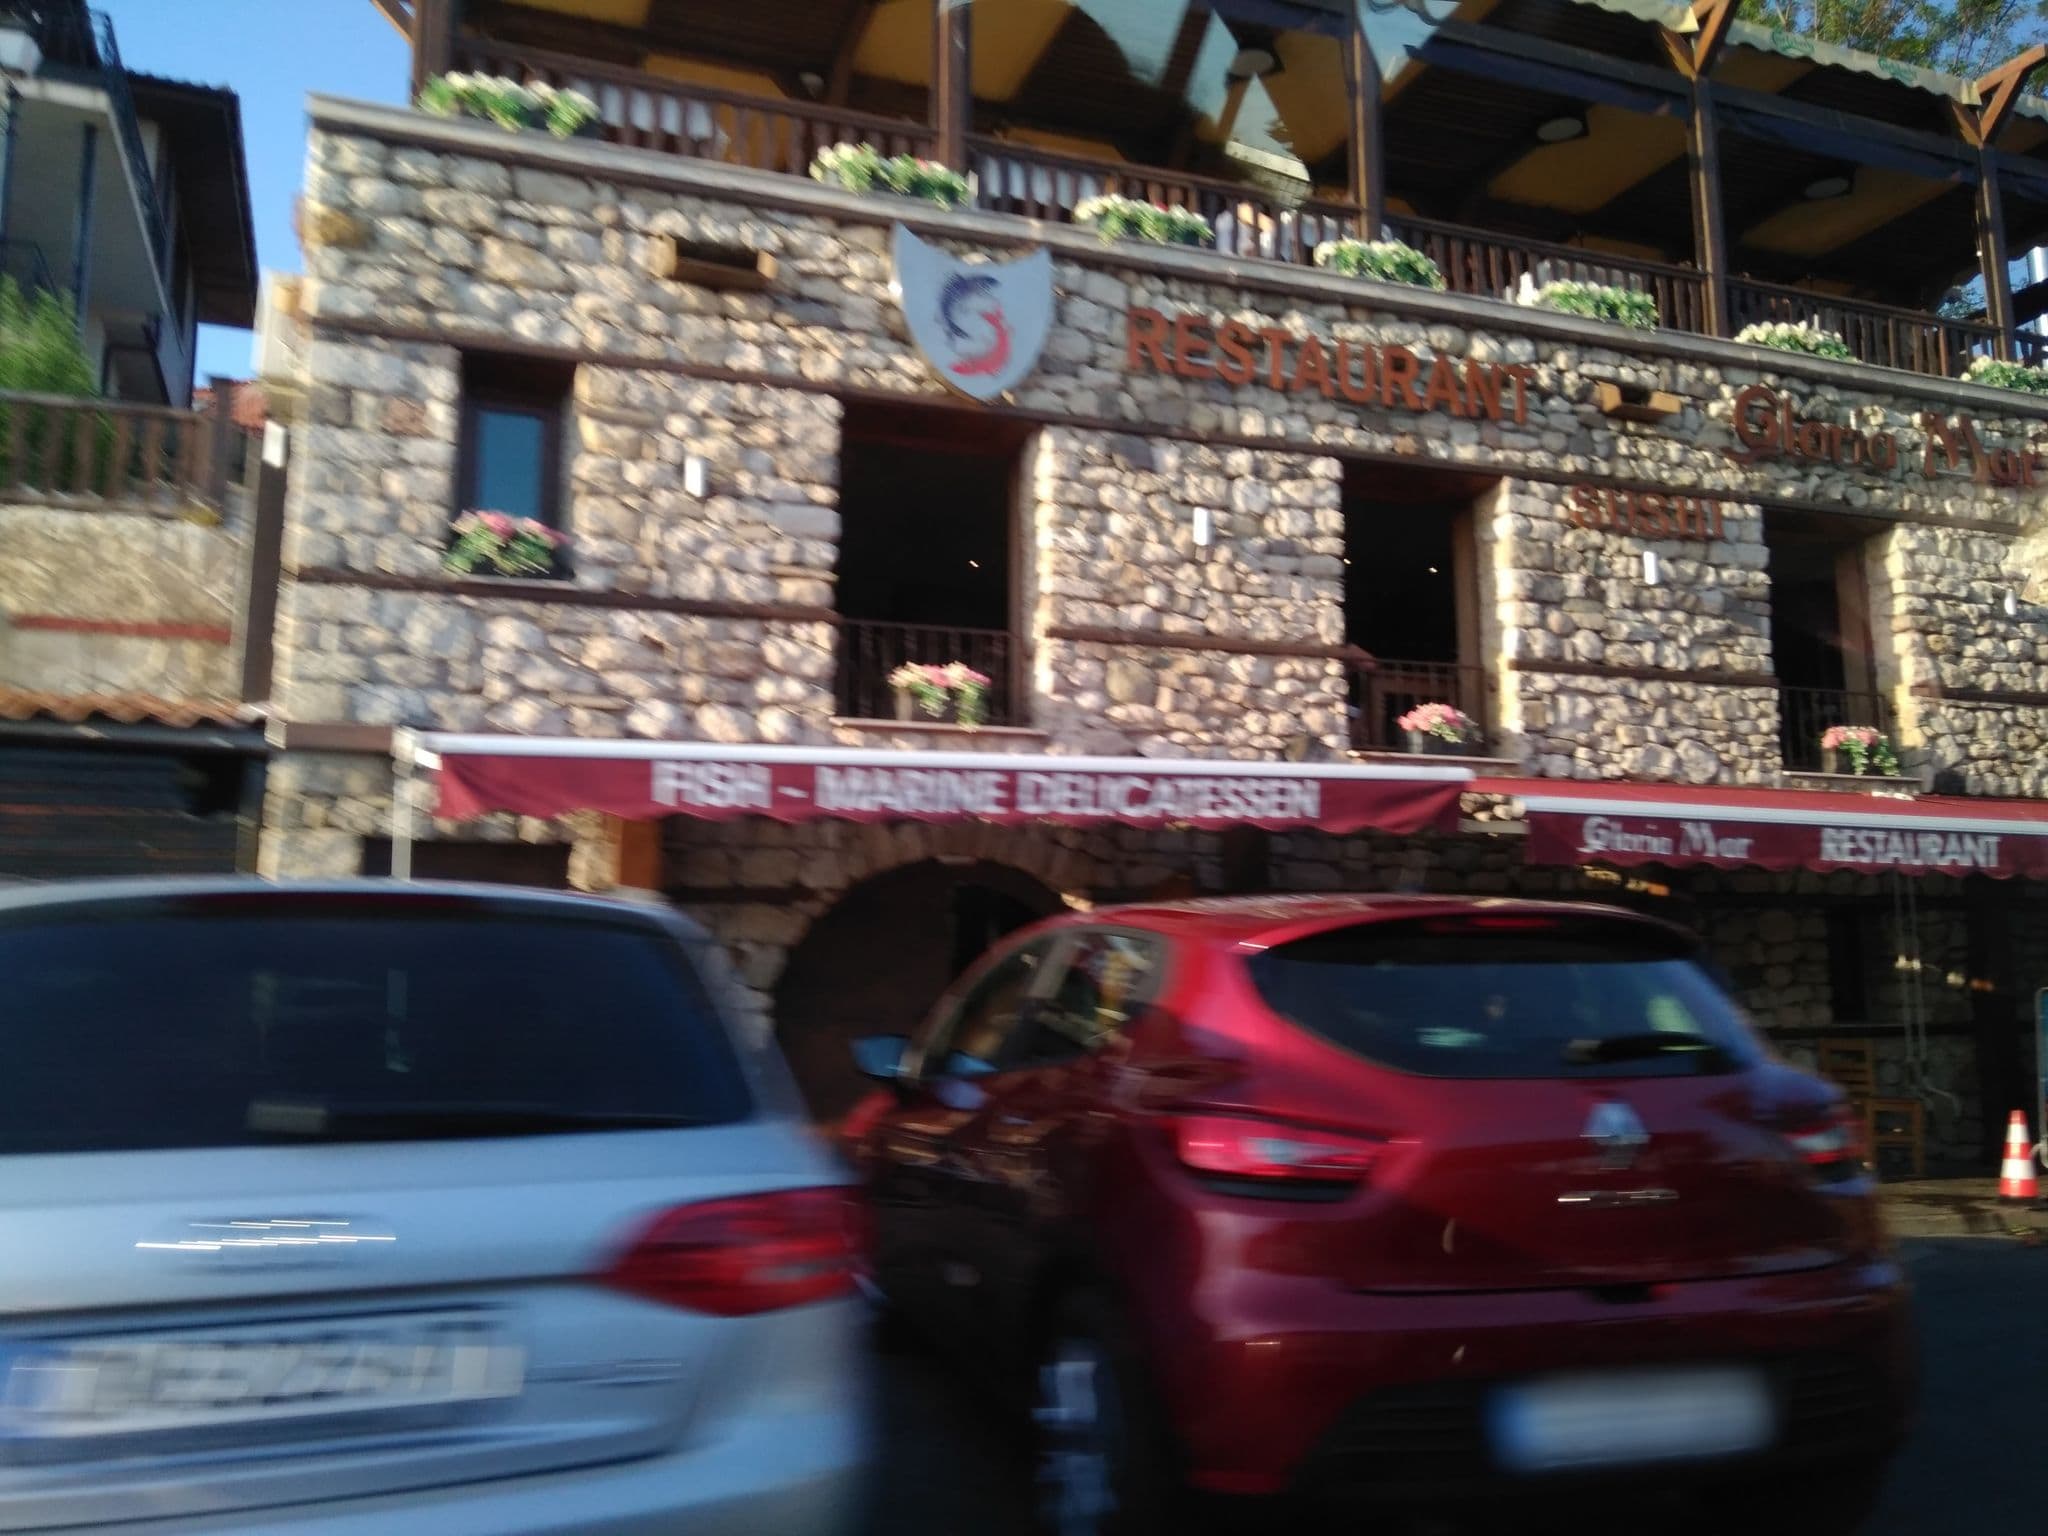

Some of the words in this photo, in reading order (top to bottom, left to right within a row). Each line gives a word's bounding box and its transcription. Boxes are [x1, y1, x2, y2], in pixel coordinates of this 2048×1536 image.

[1126, 306, 1535, 426] RESTAURANT
[1921, 410, 2041, 487] Mar
[651, 760, 773, 809] FISH
[814, 765, 1009, 815] MARINE
[1015, 771, 1321, 819] DELICATESSEN
[1820, 826, 2001, 868] RESTAURANT
